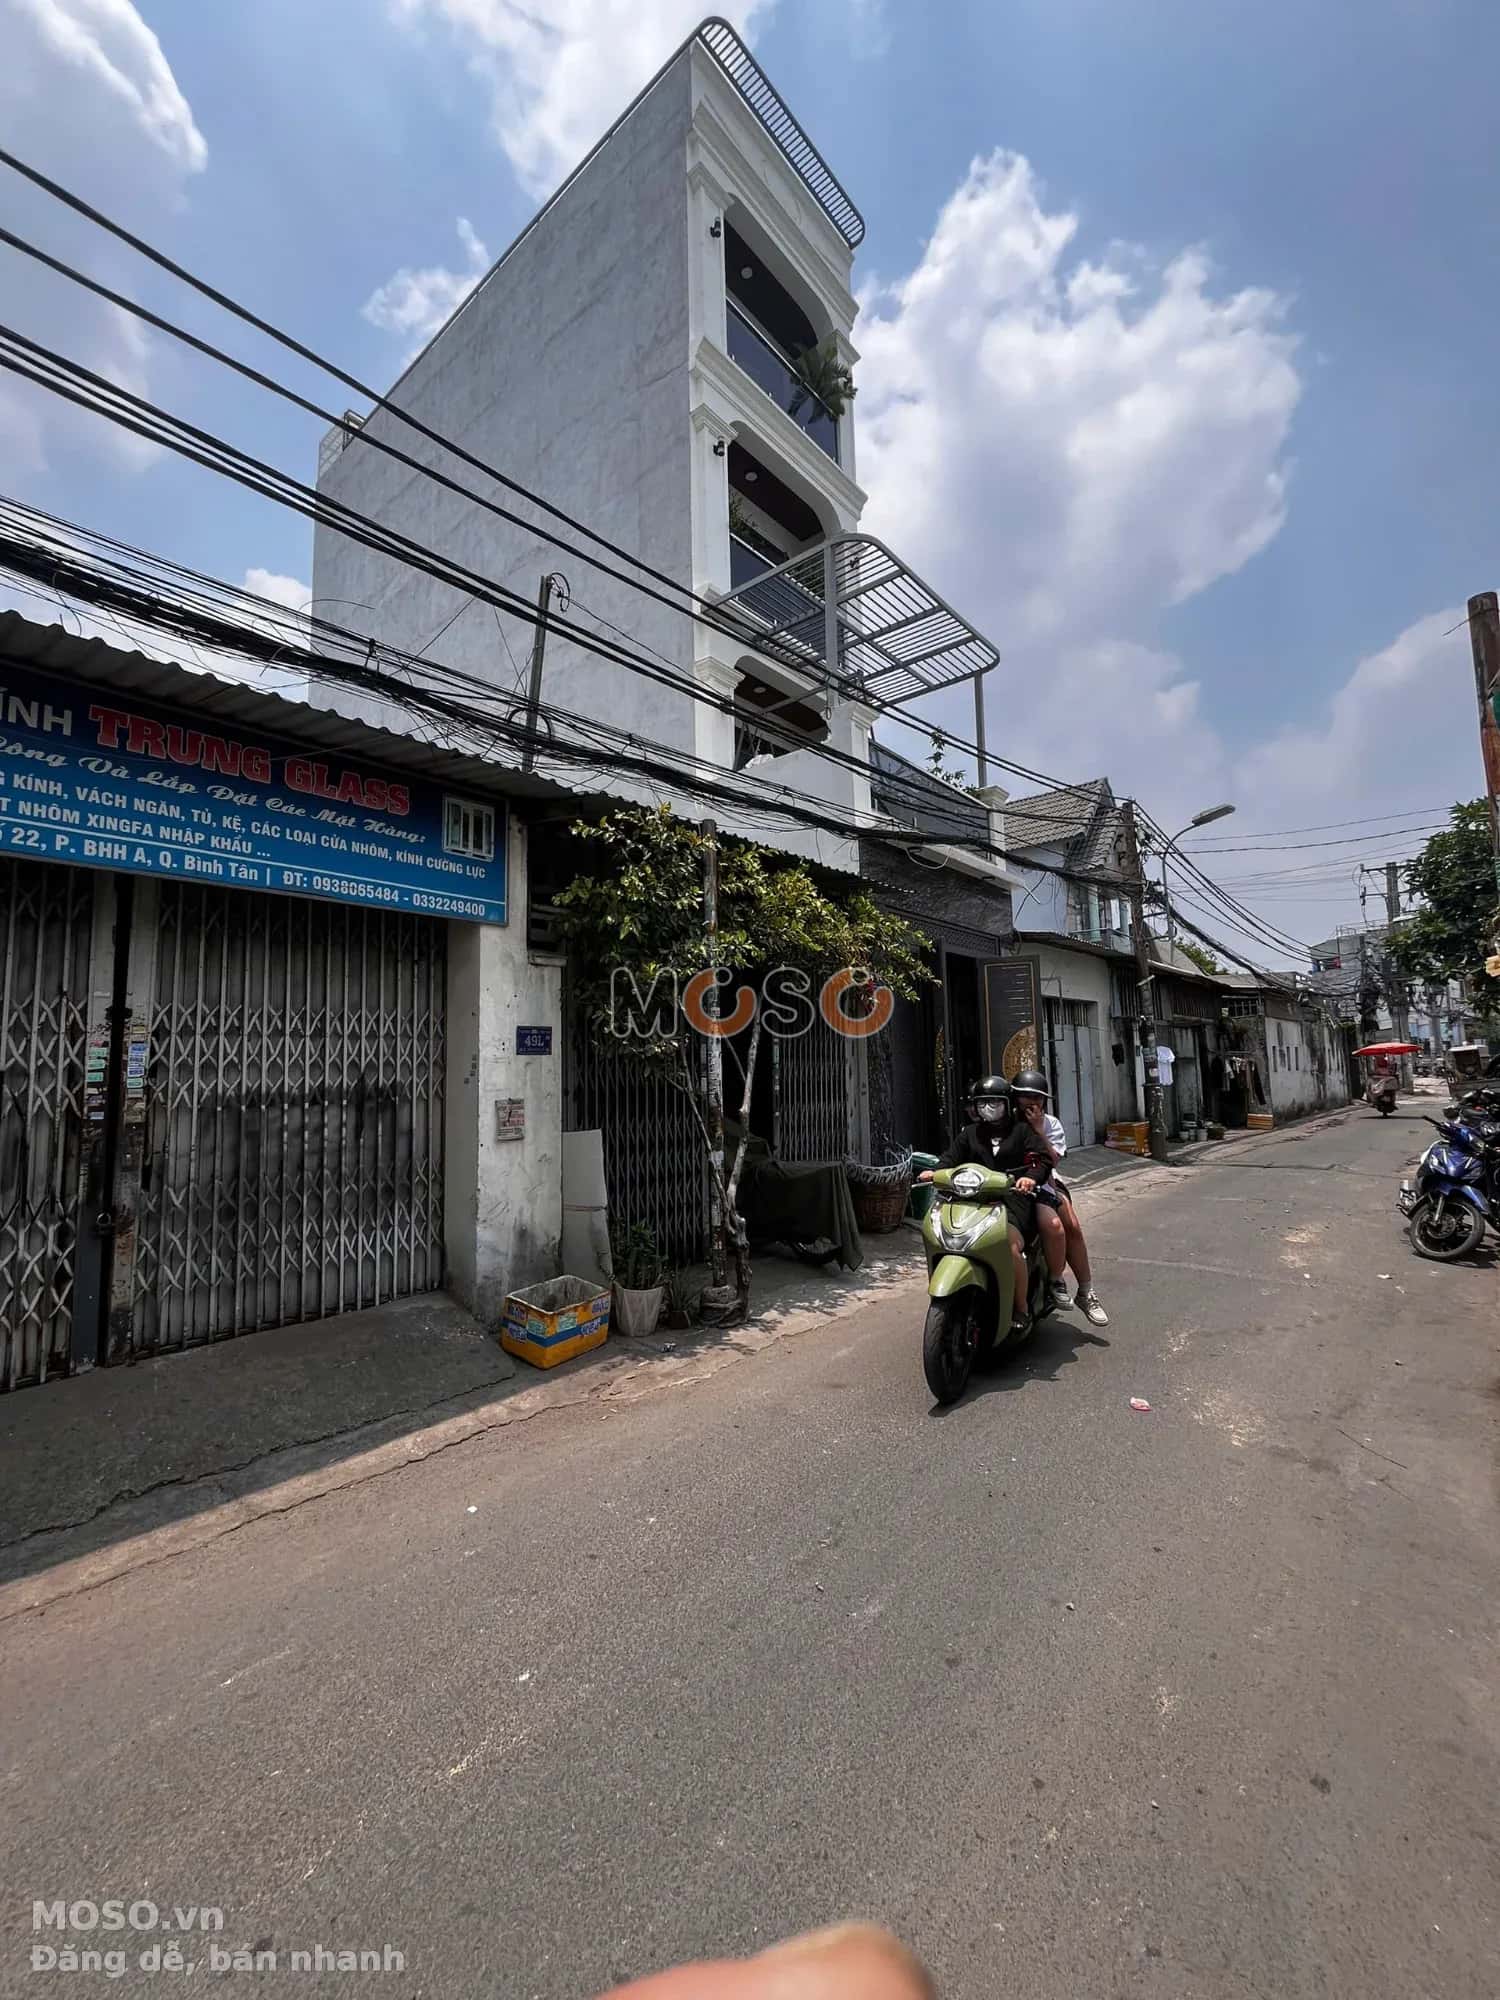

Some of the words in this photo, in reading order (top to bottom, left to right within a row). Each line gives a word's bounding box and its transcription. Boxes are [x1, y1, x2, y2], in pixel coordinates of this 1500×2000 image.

[78, 757, 130, 779] Và
[137, 771, 198, 794] Lắp
[207, 785, 257, 807] Đặt
[265, 797, 306, 817] Các
[312, 808, 357, 829] Mặt
[363, 818, 426, 844] Hàng:
[88, 704, 272, 785] TRUNG
[285, 758, 409, 815] GLASS
[13, 773, 68, 800] KÍNH,
[76, 786, 127, 808] VÁCH
[134, 797, 185, 821] NGĂN,
[191, 808, 216, 828] TỦ,
[222, 815, 245, 833] KỆ,
[251, 821, 281, 838] CÁC
[286, 828, 316, 848] LOẠI
[321, 833, 347, 851] CỬA
[351, 841, 392, 862] NHÔM,
[396, 850, 423, 866] KÍNH
[466, 866, 486, 879] LỰC
[18, 801, 80, 825] NHÔM
[87, 813, 153, 837] XINGFA
[160, 826, 205, 848] NHẬP
[211, 834, 252, 854] KHẨU
[11, 827, 47, 851] 22,
[55, 834, 76, 853] P.
[83, 839, 127, 860] BHH
[133, 847, 152, 867] A,
[159, 851, 177, 868] Q.
[184, 854, 223, 876] Bình
[228, 863, 258, 881] Tân
[283, 870, 308, 888] ĐT:
[312, 875, 399, 902] 0938065484
[412, 893, 486, 916] 0332249400
